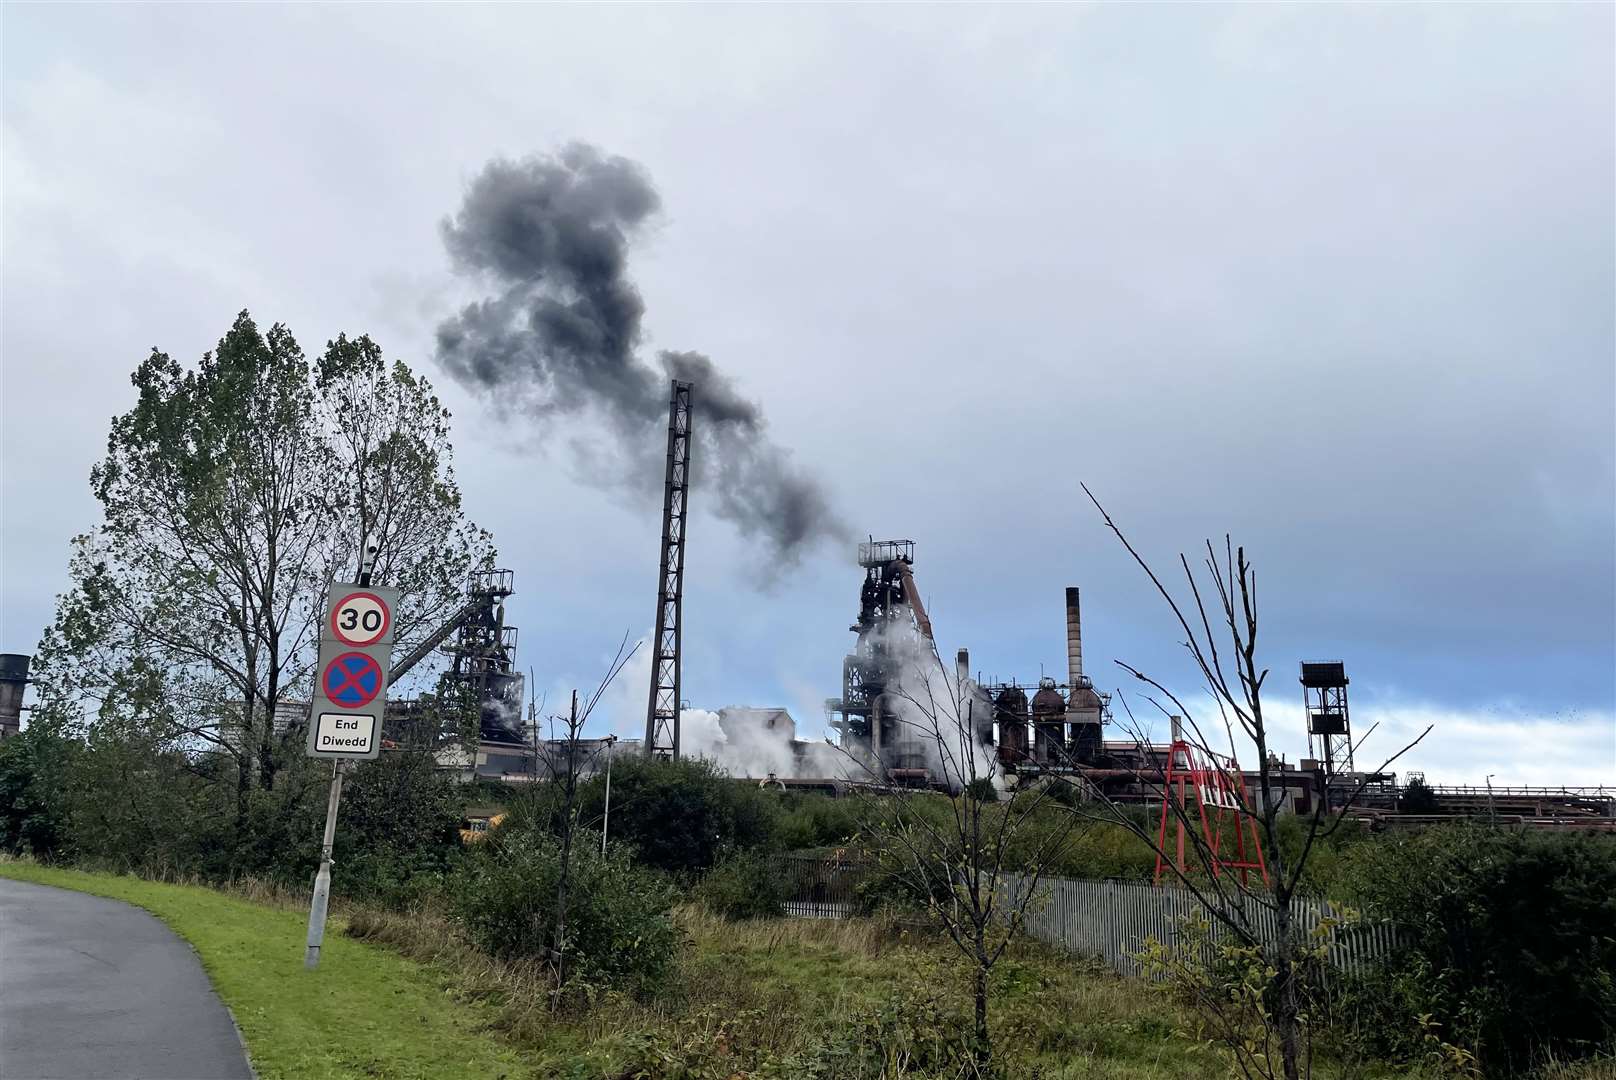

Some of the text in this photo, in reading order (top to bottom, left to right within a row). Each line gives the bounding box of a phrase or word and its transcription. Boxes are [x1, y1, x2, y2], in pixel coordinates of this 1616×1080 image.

[339, 608, 381, 632] 30
[335, 719, 358, 730] End
[322, 735, 367, 747] Diwedd
